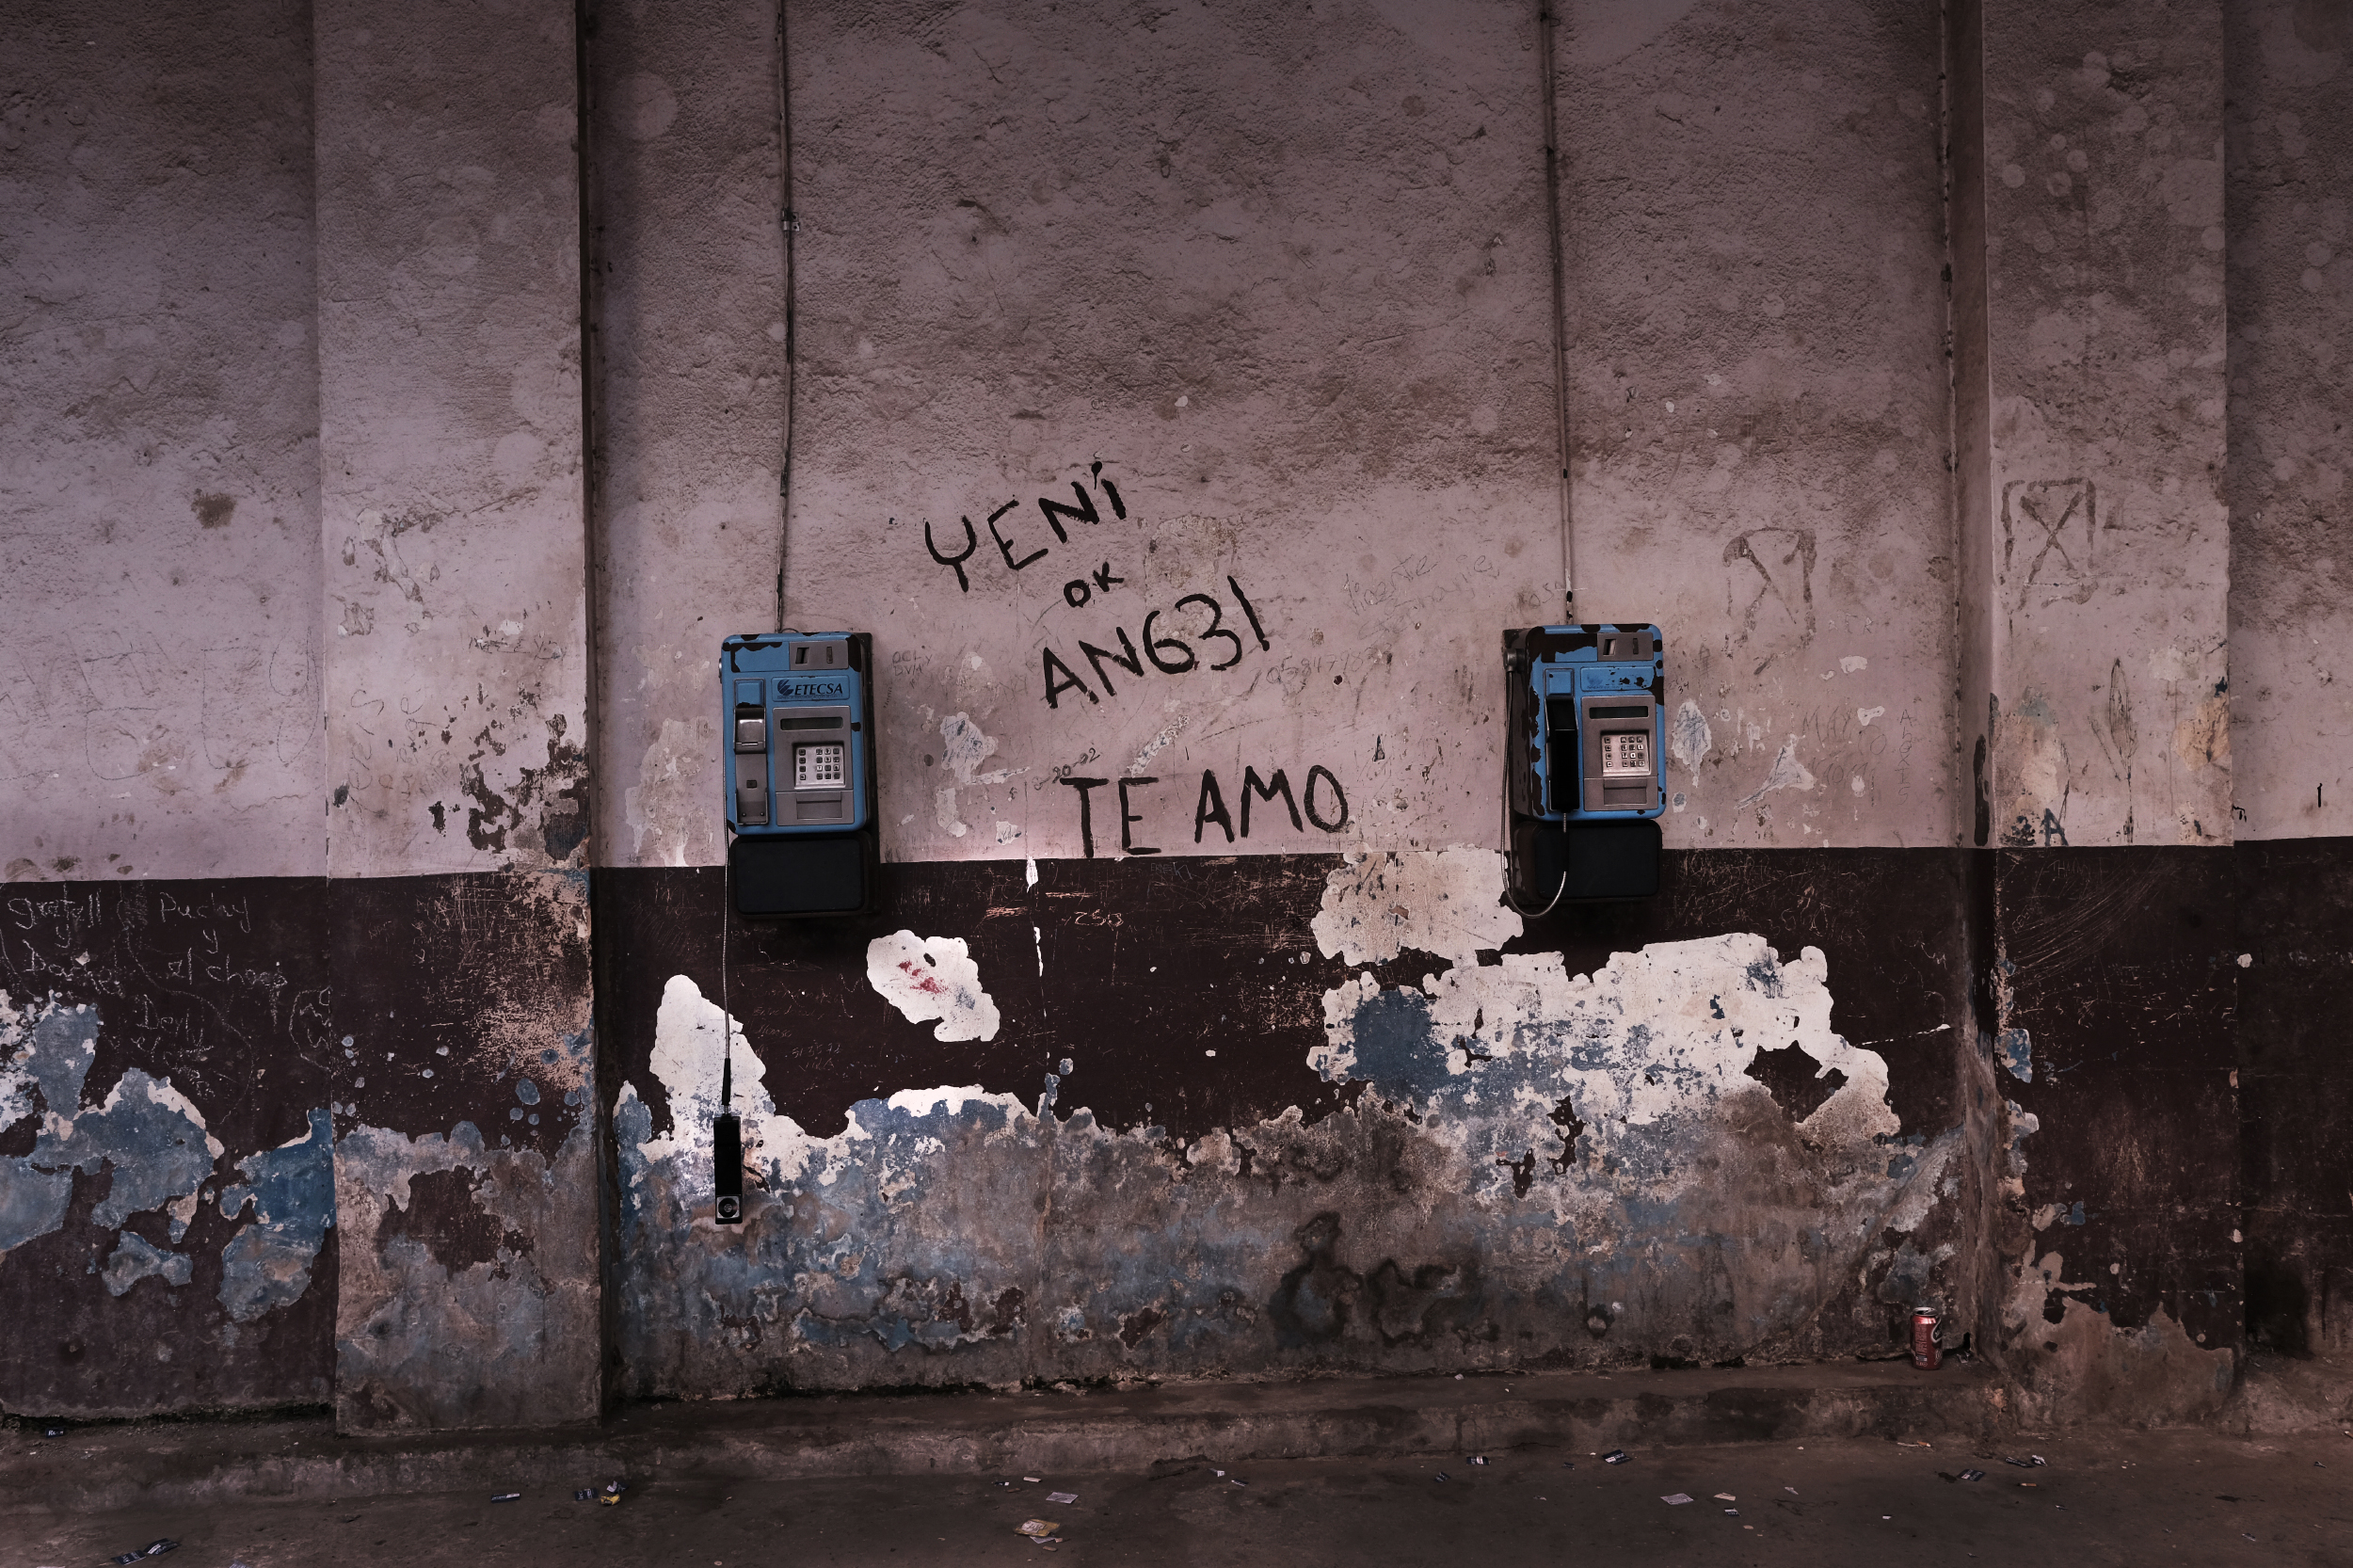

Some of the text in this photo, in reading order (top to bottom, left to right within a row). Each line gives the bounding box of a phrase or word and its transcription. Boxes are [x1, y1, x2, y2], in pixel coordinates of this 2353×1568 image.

[794, 682, 843, 696] ETECSA
[1060, 764, 1349, 857] TE AMO
